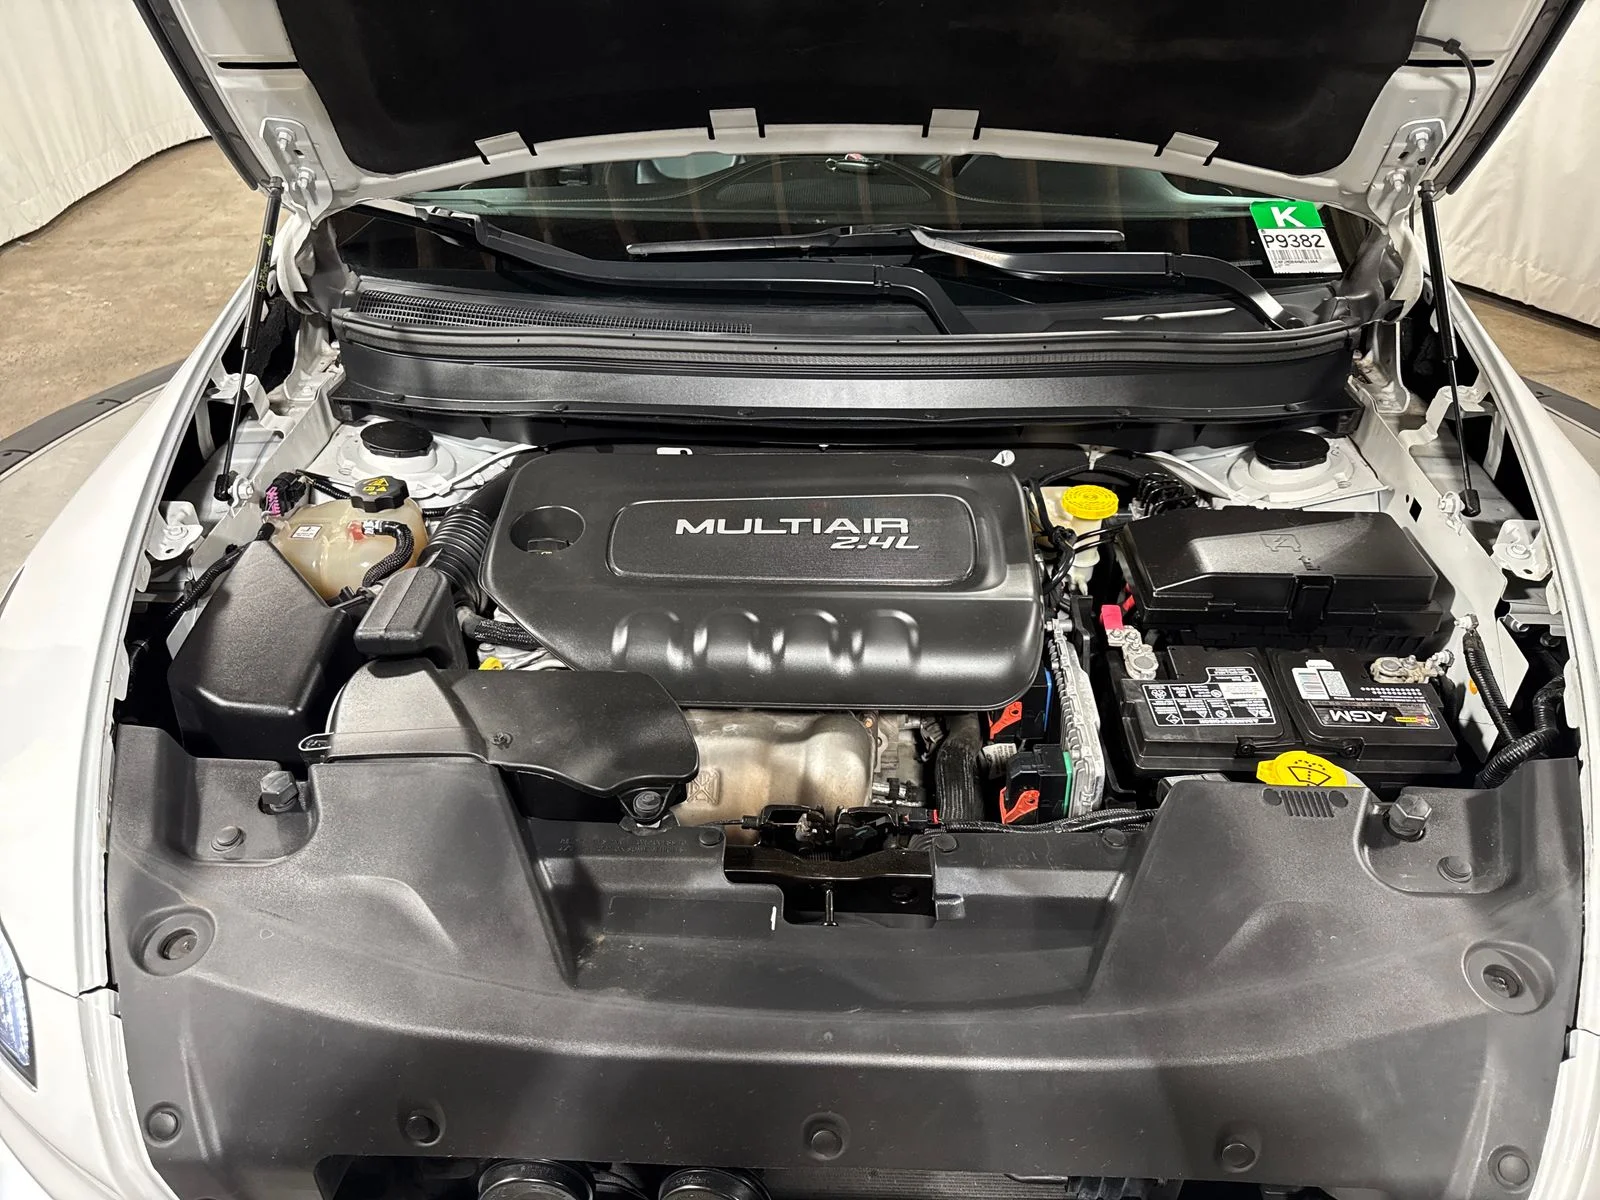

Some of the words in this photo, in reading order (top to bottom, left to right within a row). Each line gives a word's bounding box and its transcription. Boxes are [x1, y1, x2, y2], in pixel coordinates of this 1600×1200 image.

[1271, 206, 1306, 227] K
[1263, 234, 1325, 249] P9382
[675, 517, 910, 536] MULTIAIR
[830, 536, 920, 550] 2.4L
[1330, 710, 1387, 723] AGM
